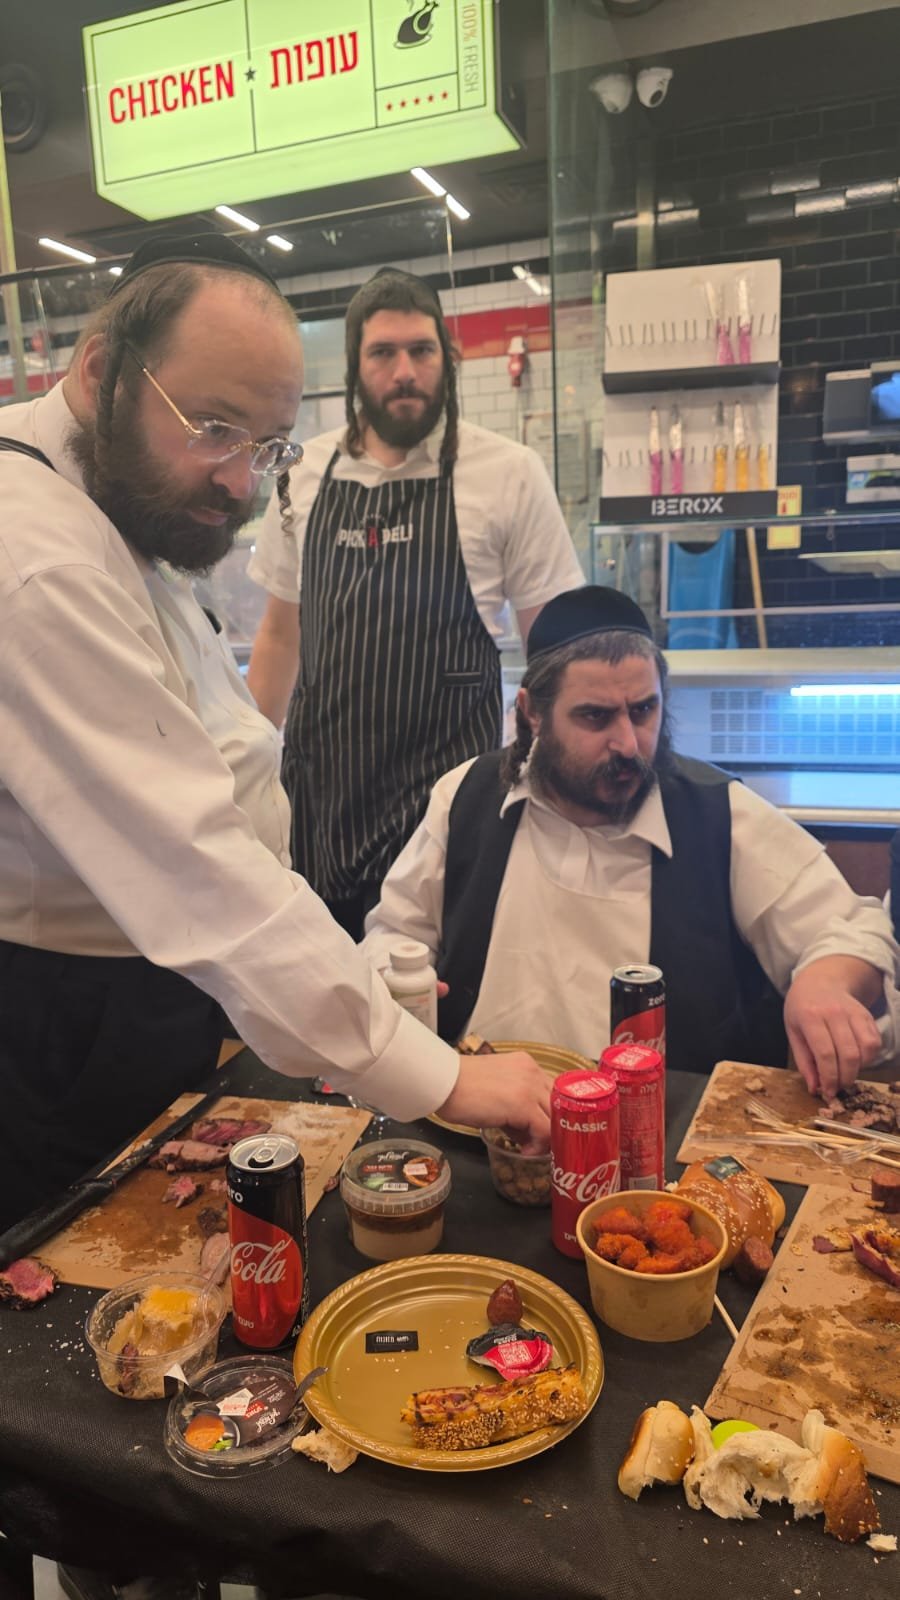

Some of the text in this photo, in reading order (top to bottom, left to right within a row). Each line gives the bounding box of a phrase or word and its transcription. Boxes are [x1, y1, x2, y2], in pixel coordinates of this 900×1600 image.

[270, 31, 359, 88] עופות
[463, 3, 479, 93] 100% FRESH
[108, 60, 235, 124] CHICKEN
[651, 497, 723, 515] BEROX
[337, 522, 413, 548] PICK A DELI
[560, 1118, 608, 1132] CLASSIC
[231, 1238, 293, 1284] Cola
